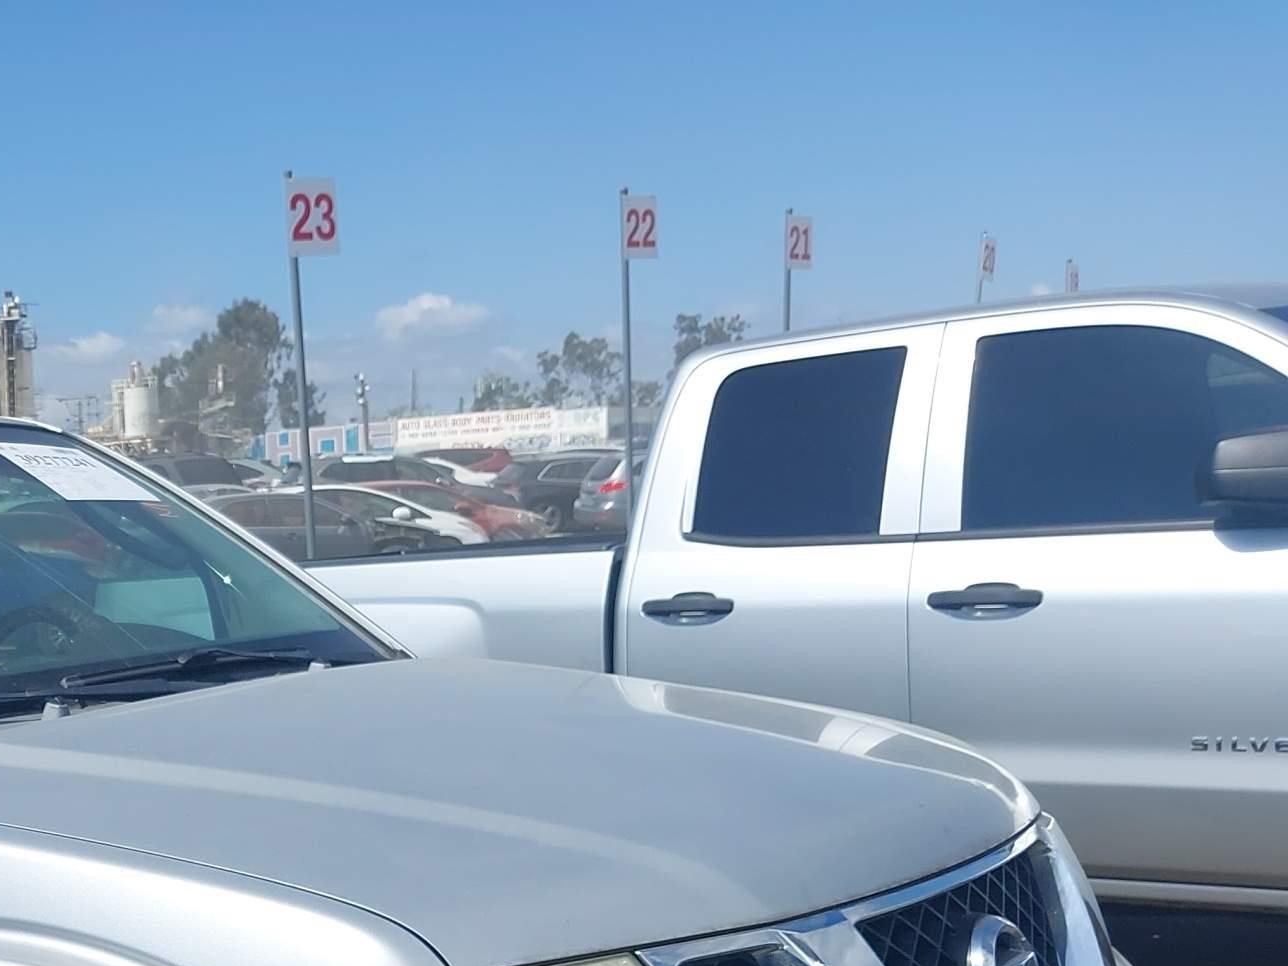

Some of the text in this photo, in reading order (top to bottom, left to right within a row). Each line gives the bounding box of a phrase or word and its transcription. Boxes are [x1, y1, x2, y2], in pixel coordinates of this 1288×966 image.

[290, 193, 335, 241] 23
[626, 208, 656, 248] 22
[789, 225, 811, 261] 21
[982, 243, 996, 274] 20
[14, 454, 97, 468] 39277241
